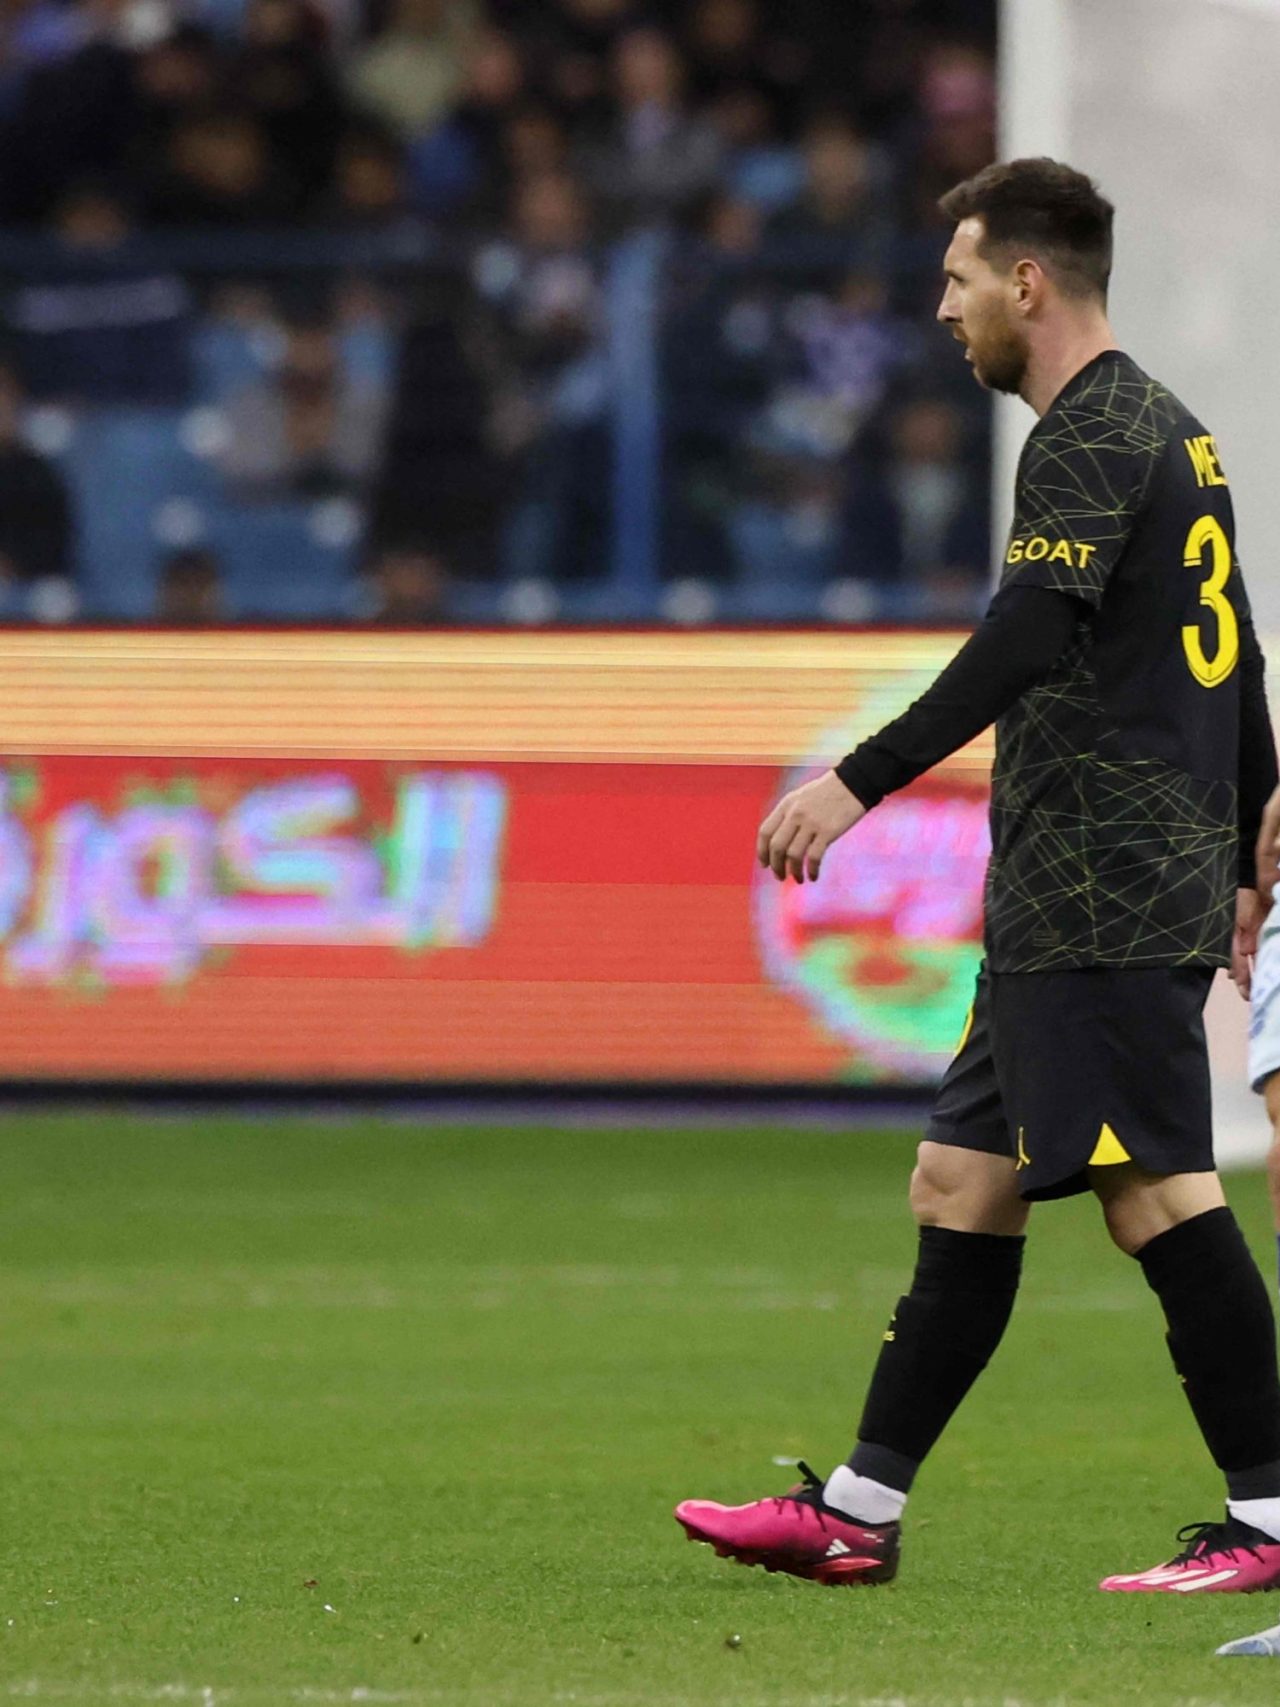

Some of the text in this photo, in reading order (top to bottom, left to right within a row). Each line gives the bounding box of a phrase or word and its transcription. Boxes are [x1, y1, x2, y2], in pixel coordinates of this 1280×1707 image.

[1184, 435, 1229, 488] ME
[1006, 536, 1096, 569] GOAT
[1182, 515, 1239, 688] 3
